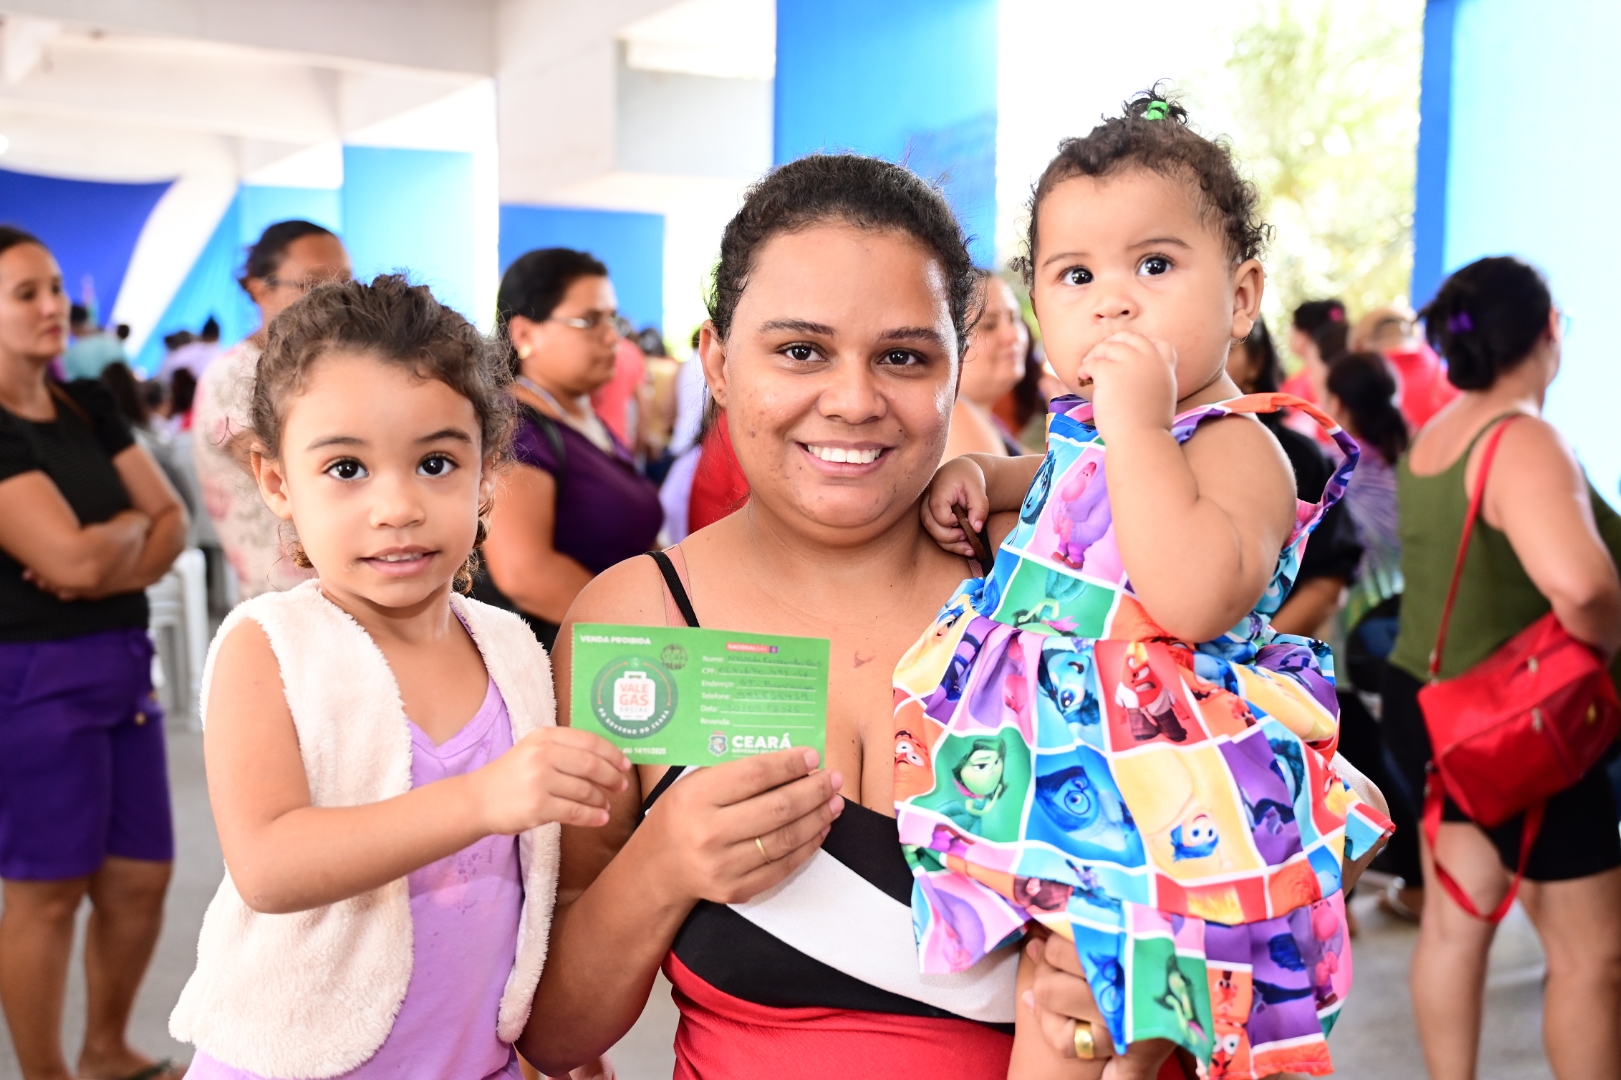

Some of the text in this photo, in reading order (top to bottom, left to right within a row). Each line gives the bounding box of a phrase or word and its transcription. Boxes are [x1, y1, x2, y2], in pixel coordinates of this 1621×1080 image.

[580, 635, 652, 645] VENDA PROIBIDA
[702, 655, 725, 663] Nome:
[702, 667, 716, 675] CPF:
[619, 683, 649, 693] VALE
[701, 680, 735, 688] Endereço:
[701, 692, 731, 700] Telefone:
[700, 717, 731, 725] Revenda:
[605, 719, 637, 735] GOVERNO
[639, 727, 650, 735] DO
[731, 732, 793, 749] CEARÁ
[634, 747, 667, 755] 14/11/2025
